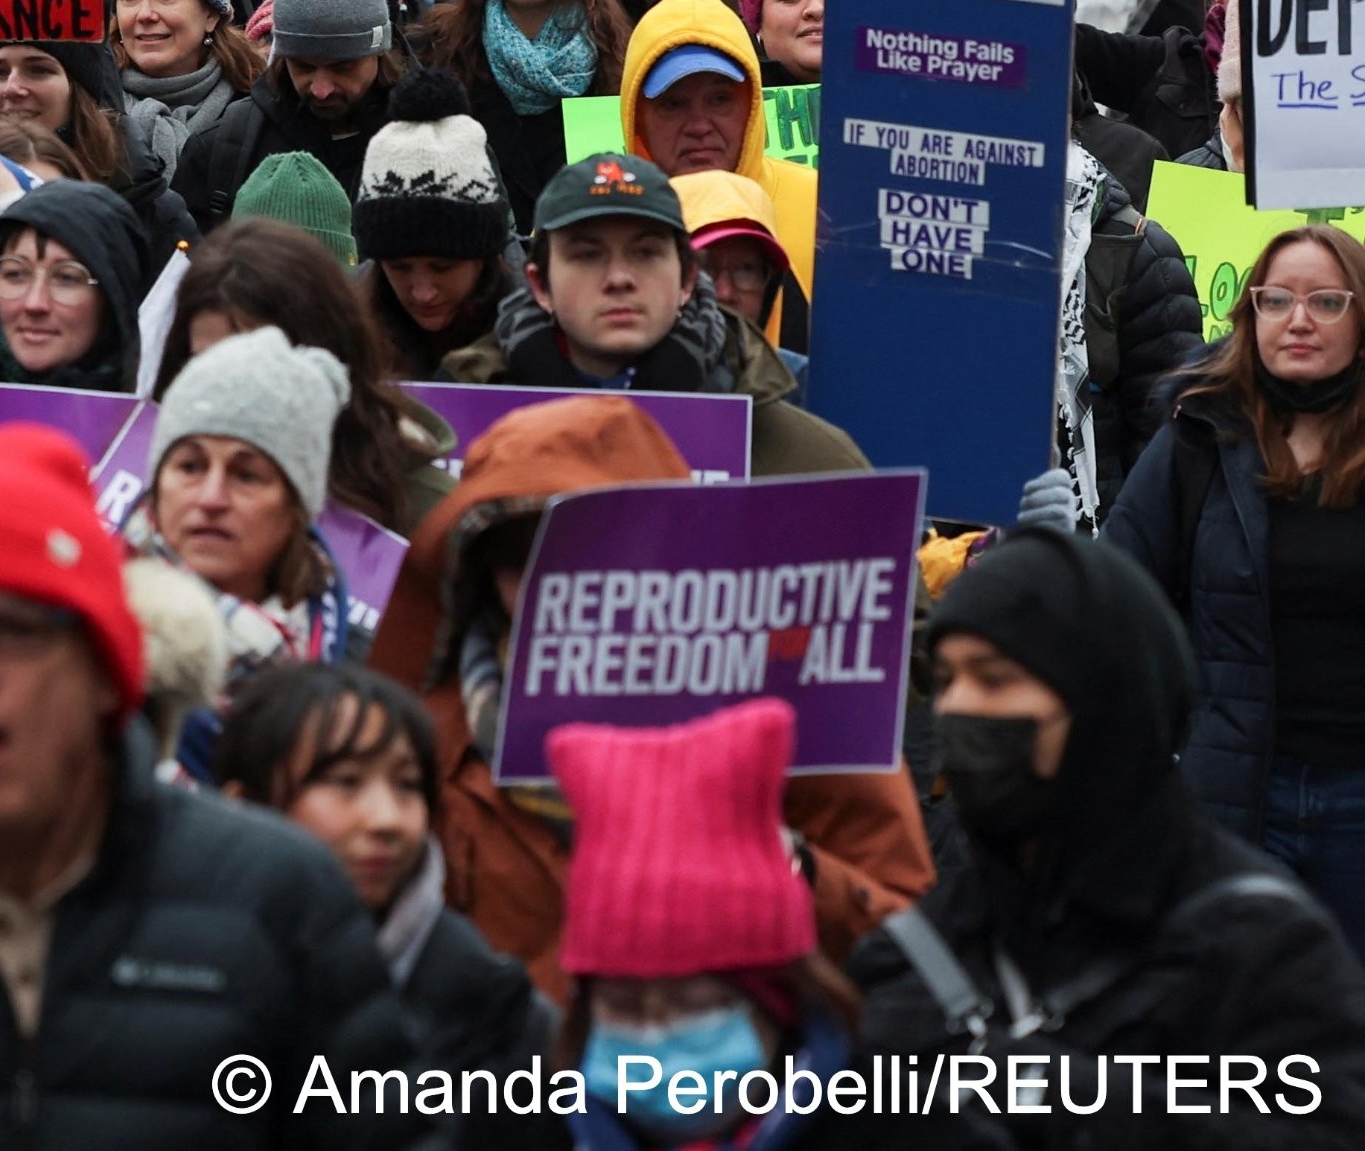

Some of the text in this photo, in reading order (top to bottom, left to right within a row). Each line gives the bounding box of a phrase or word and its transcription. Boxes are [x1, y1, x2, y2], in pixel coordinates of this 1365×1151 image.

[866, 28, 1015, 65] Nothing Fails
[876, 49, 1004, 84] Like Prayer
[849, 122, 1038, 167] IF YOU ARE AGAINST
[895, 153, 981, 186] ABORTION
[885, 190, 980, 225] DON'T
[891, 221, 973, 252] HAVE
[901, 248, 967, 277] ONE
[534, 557, 896, 634] REPRODUCTIVE
[525, 622, 886, 696] FREEDOM ALL
